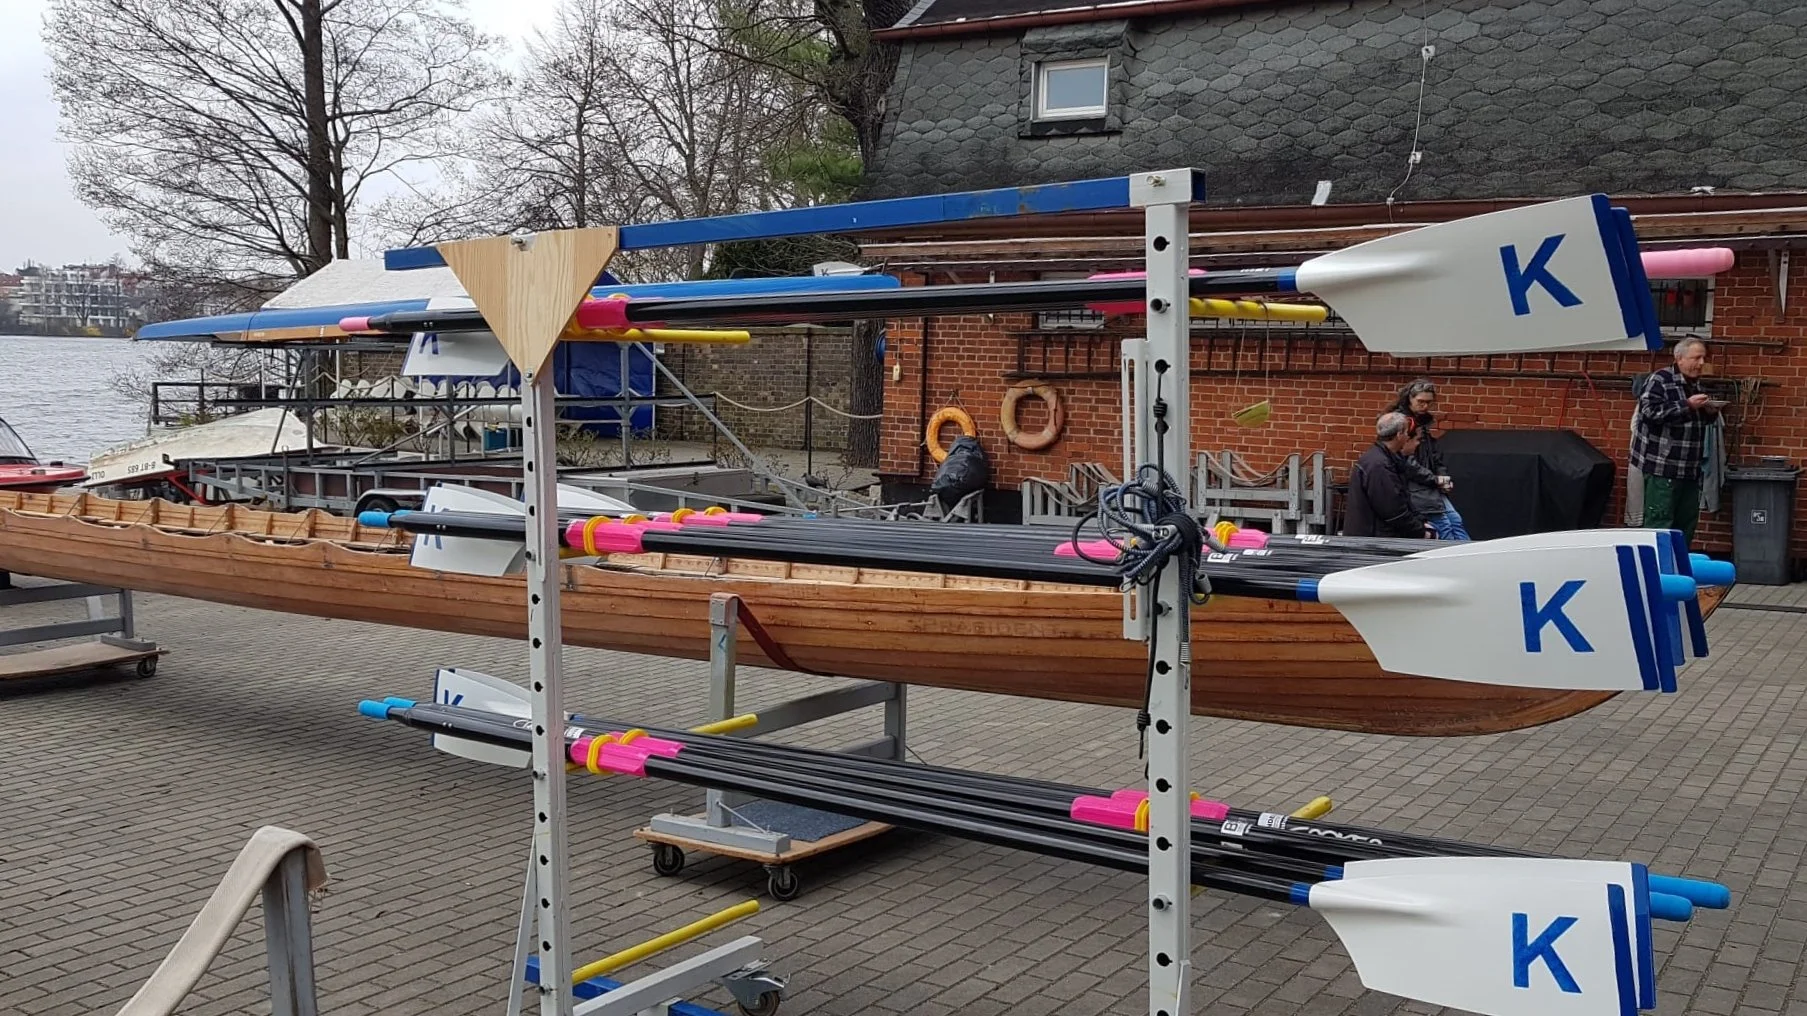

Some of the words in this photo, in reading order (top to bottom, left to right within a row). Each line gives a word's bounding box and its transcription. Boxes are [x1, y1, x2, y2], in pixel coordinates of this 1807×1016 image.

[1499, 233, 1584, 316] K
[1520, 580, 1595, 653] K
[1512, 912, 1583, 994] K
